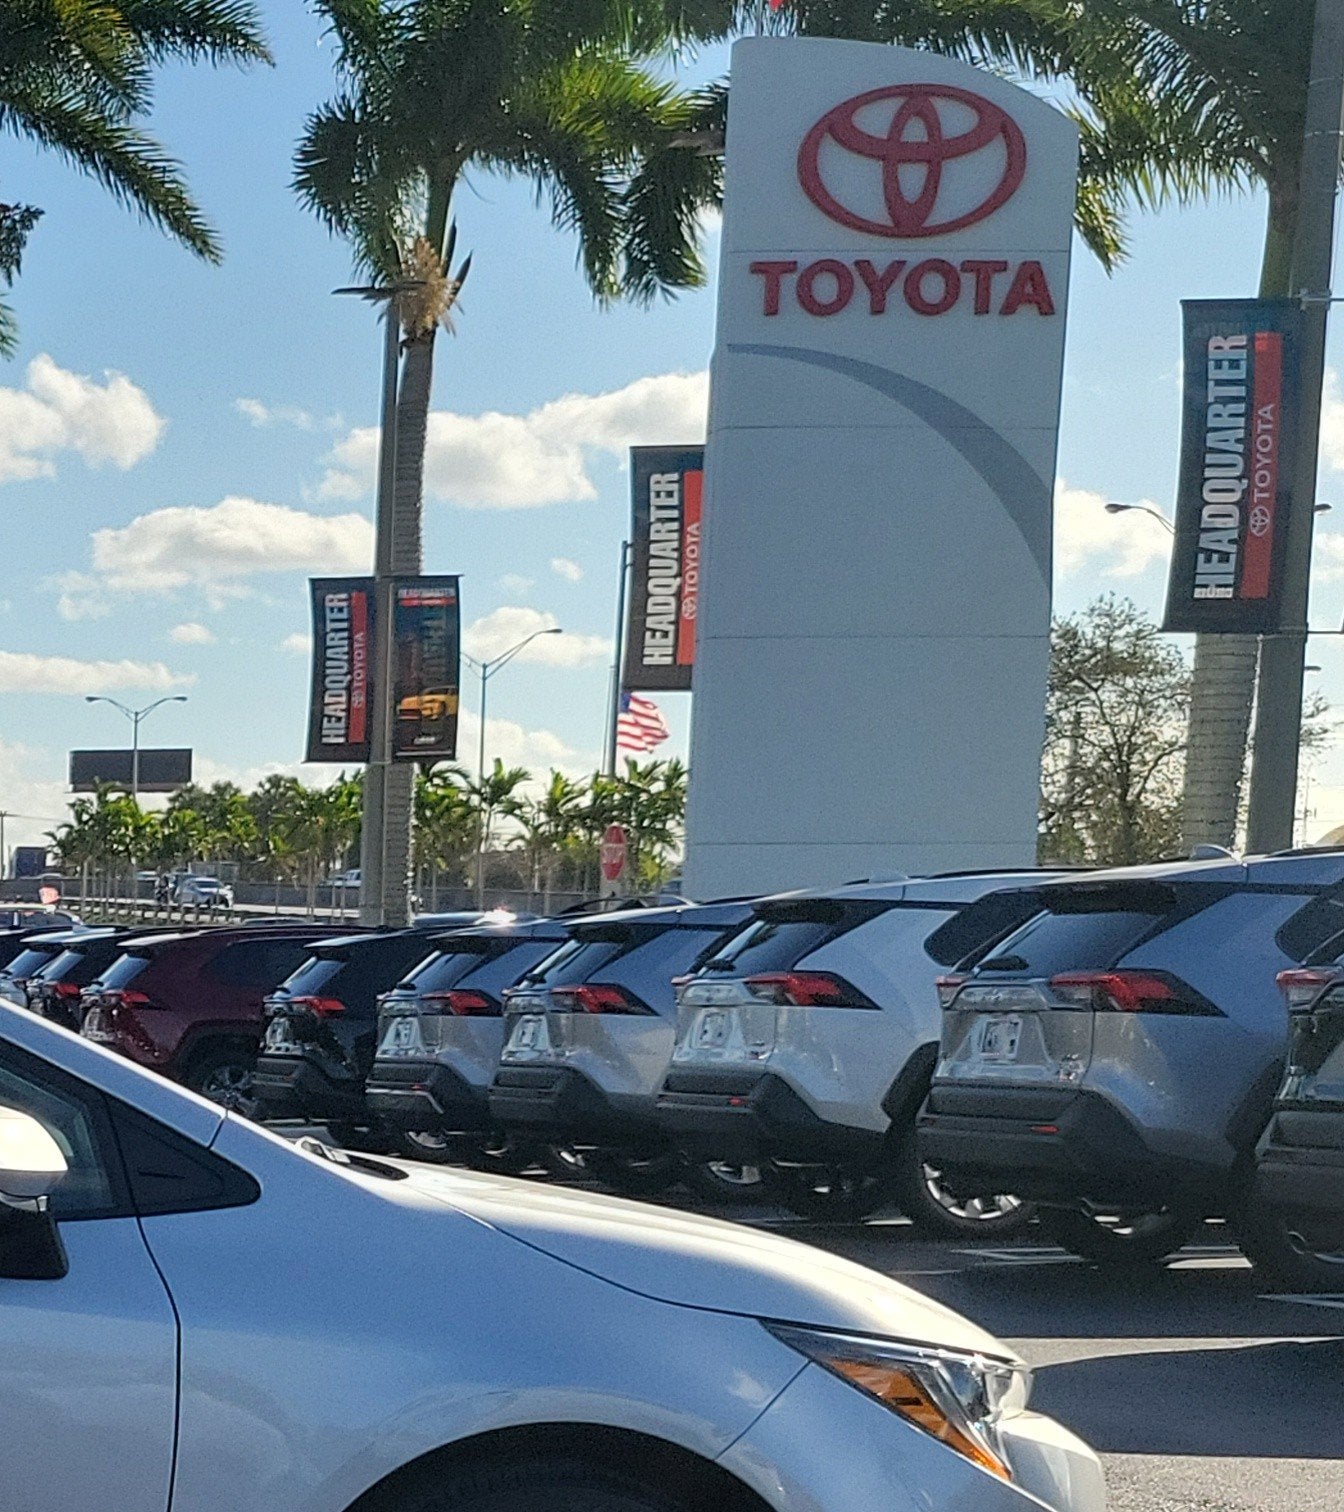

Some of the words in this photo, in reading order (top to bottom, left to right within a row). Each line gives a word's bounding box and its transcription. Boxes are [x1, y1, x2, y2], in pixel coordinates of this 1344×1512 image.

[749, 257, 1056, 317] TOYOTA
[1193, 333, 1248, 600] HEADQUARTER
[1253, 403, 1275, 502] TOYOTA
[642, 471, 682, 665] HEADQUARTER
[683, 521, 701, 596] TOYOTA
[321, 592, 352, 744] HEADQUARTER
